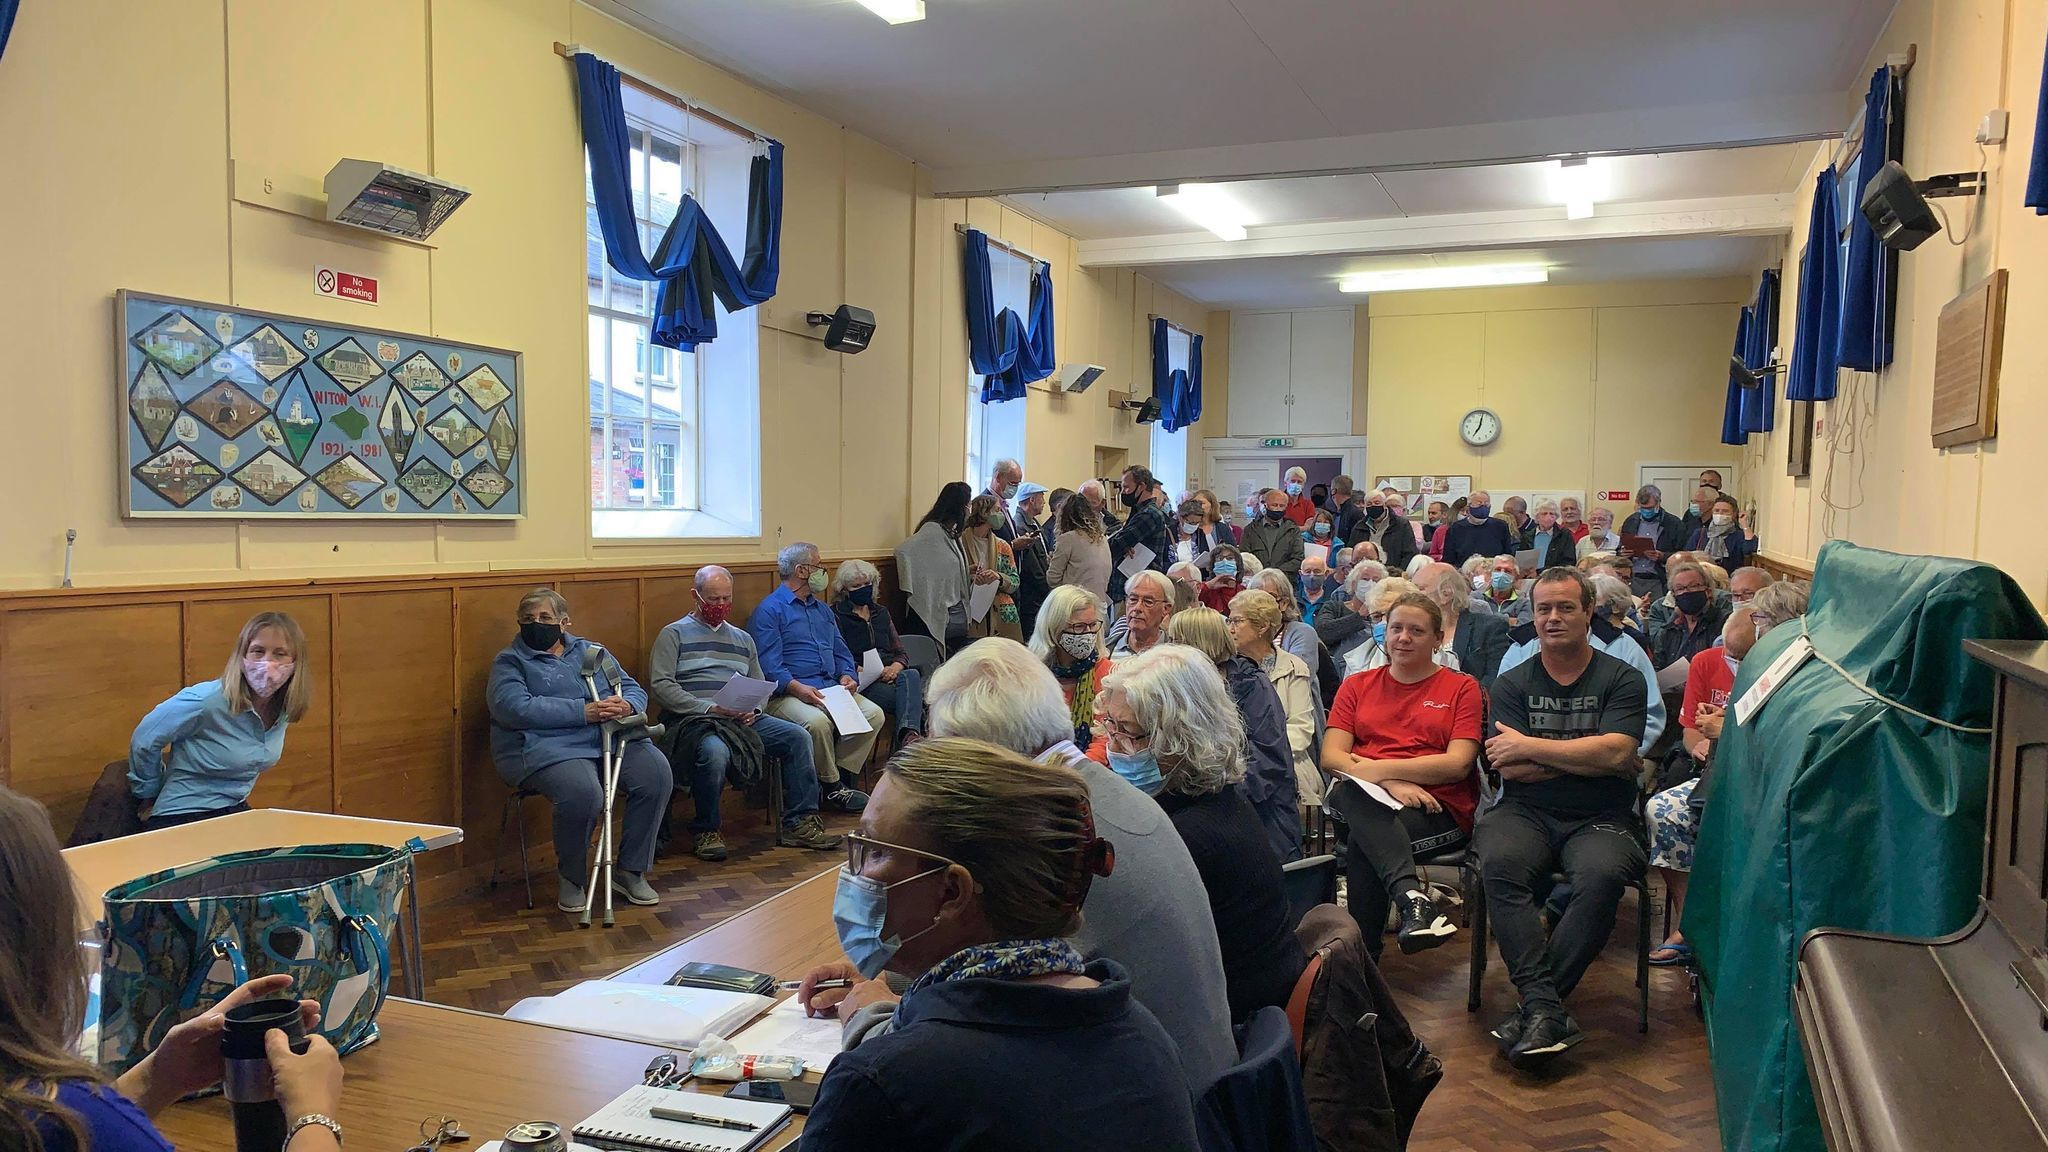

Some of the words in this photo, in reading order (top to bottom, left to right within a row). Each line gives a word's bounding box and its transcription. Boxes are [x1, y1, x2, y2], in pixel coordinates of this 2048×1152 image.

[352, 276, 363, 287] No
[342, 286, 373, 301] smoking
[314, 390, 348, 406] NITON
[357, 393, 382, 409] W.I.
[320, 441, 344, 456] 1921
[360, 443, 382, 457] 1981
[1528, 695, 1599, 711] UNDER
